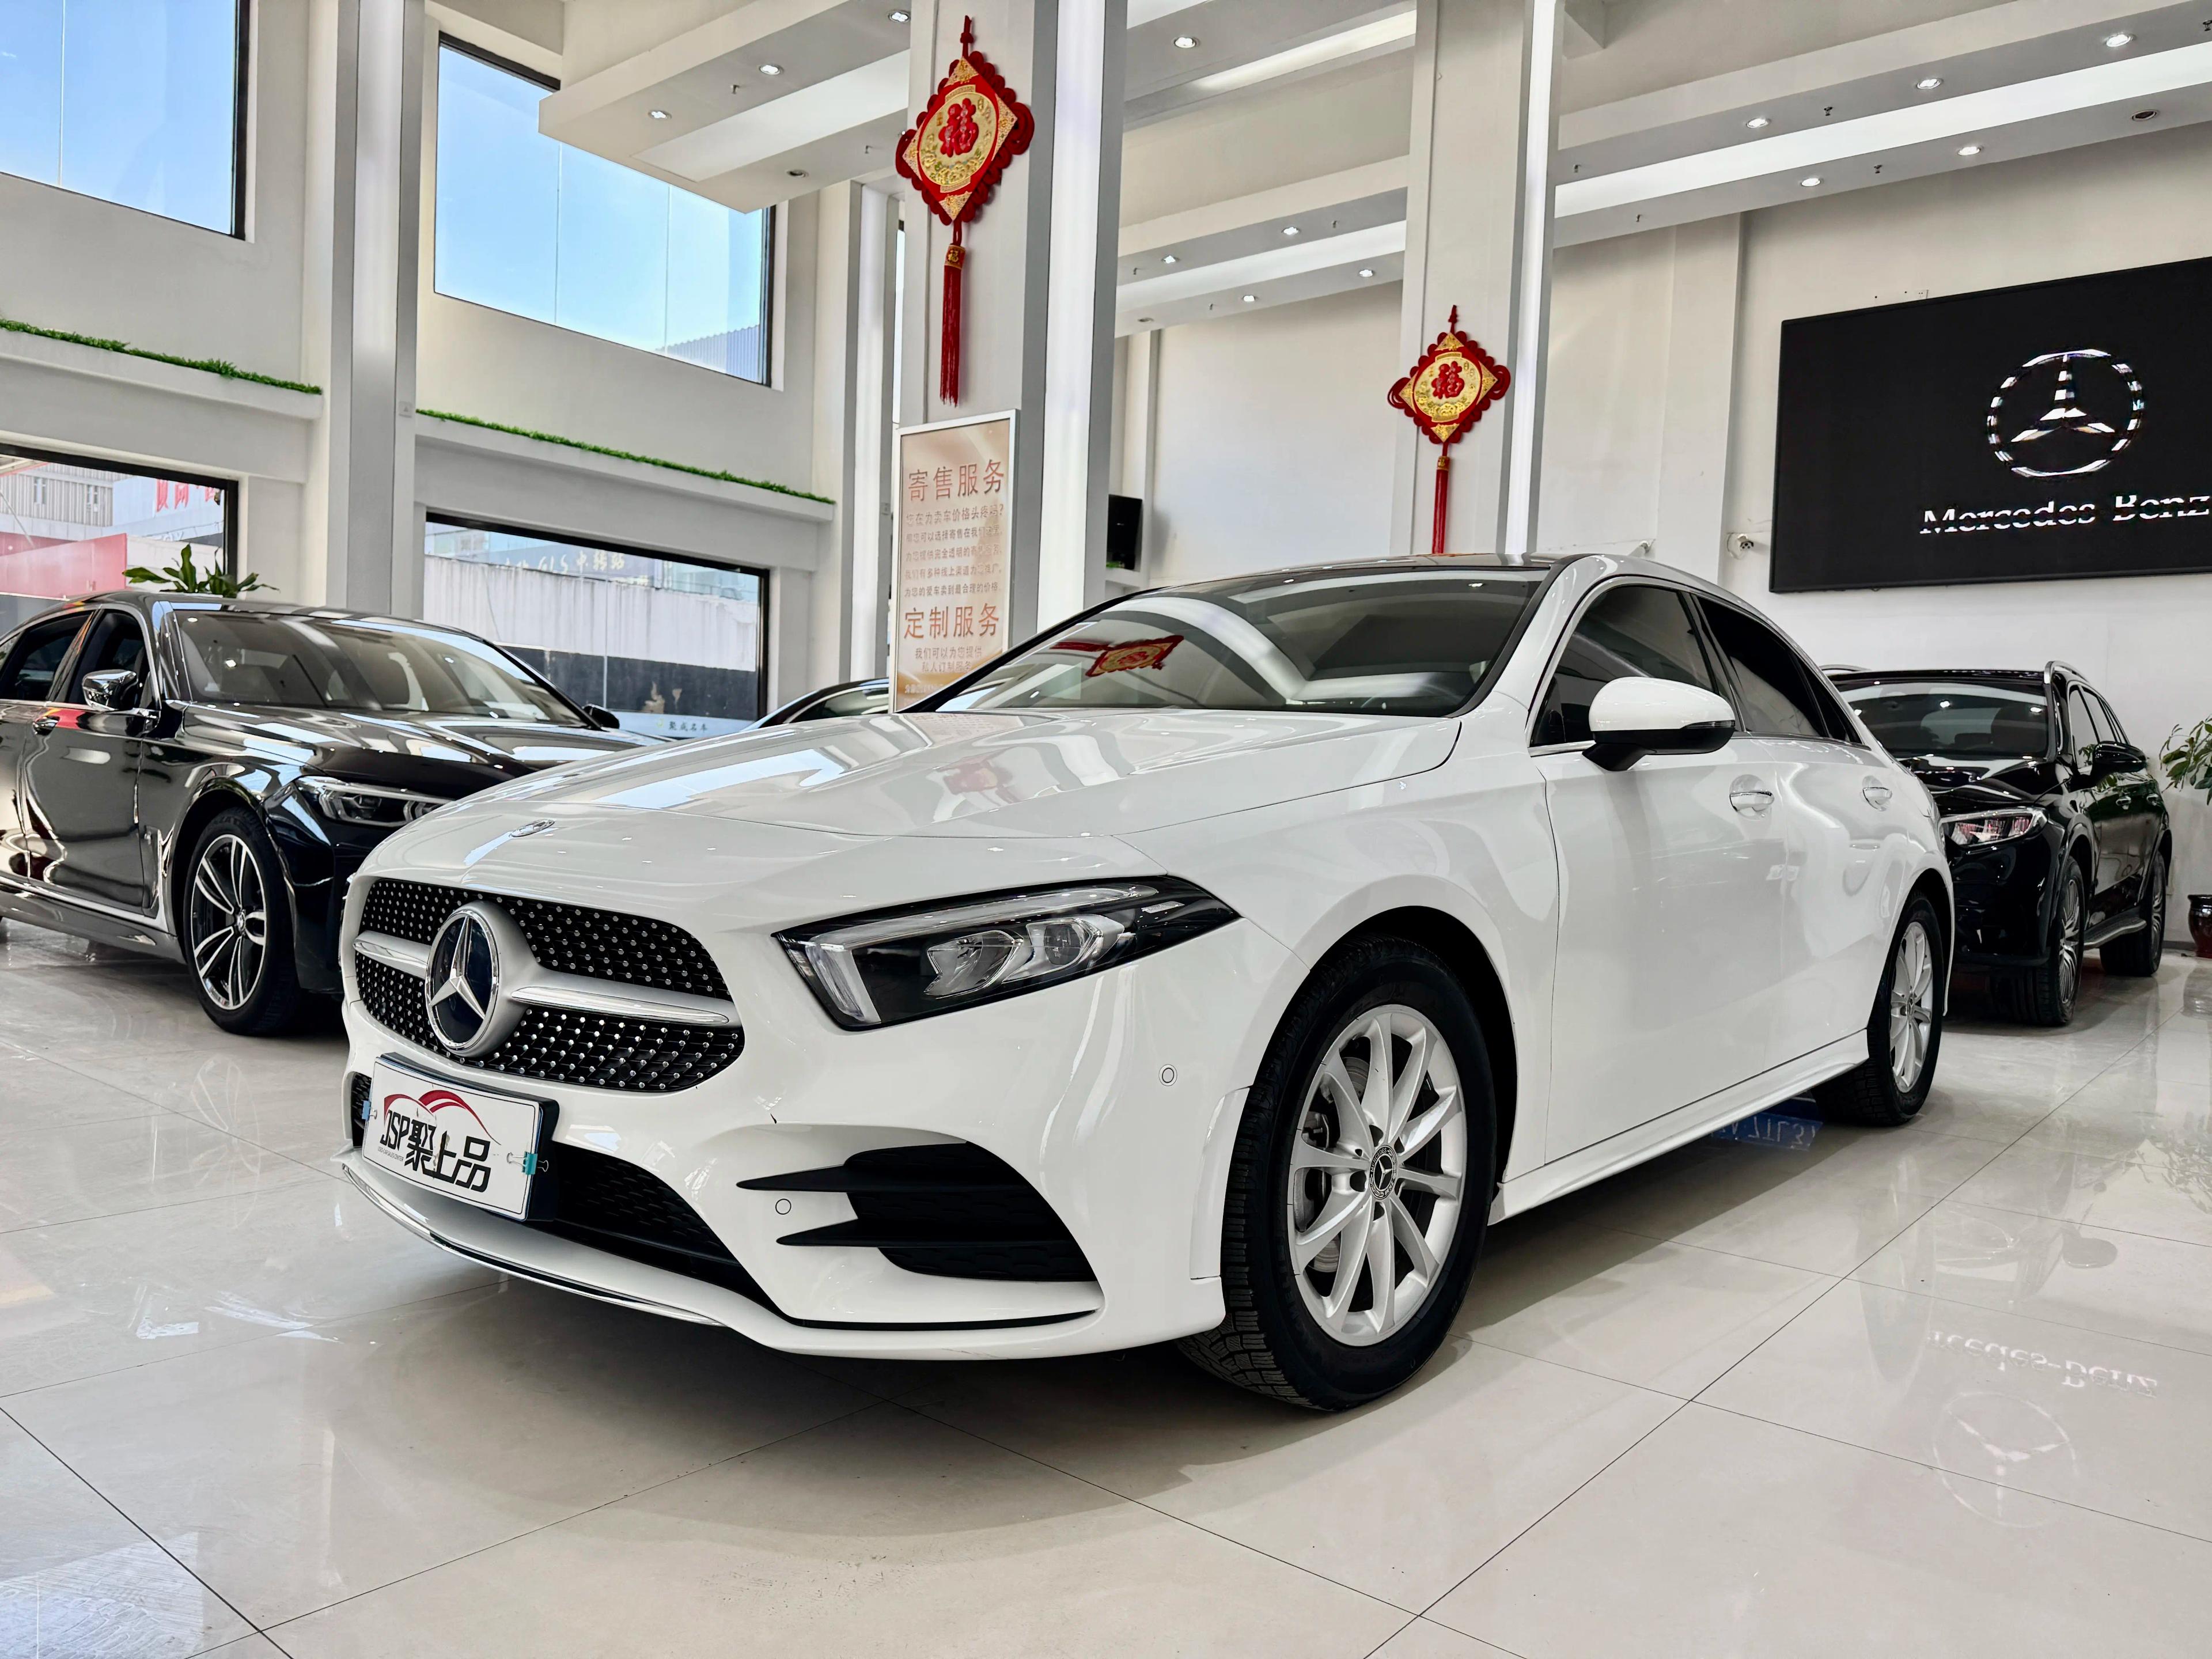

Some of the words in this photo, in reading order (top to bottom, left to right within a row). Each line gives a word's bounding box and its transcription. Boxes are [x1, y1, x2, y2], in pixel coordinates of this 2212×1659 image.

[938, 99, 979, 158] 福
[1431, 361, 1464, 399] 福
[908, 459, 1004, 501] 寄售服务
[904, 603, 999, 639] 定制服务
[915, 646, 982, 659] 我们可以为您提供
[1370, 1147, 1387, 1172] MERCEDES
